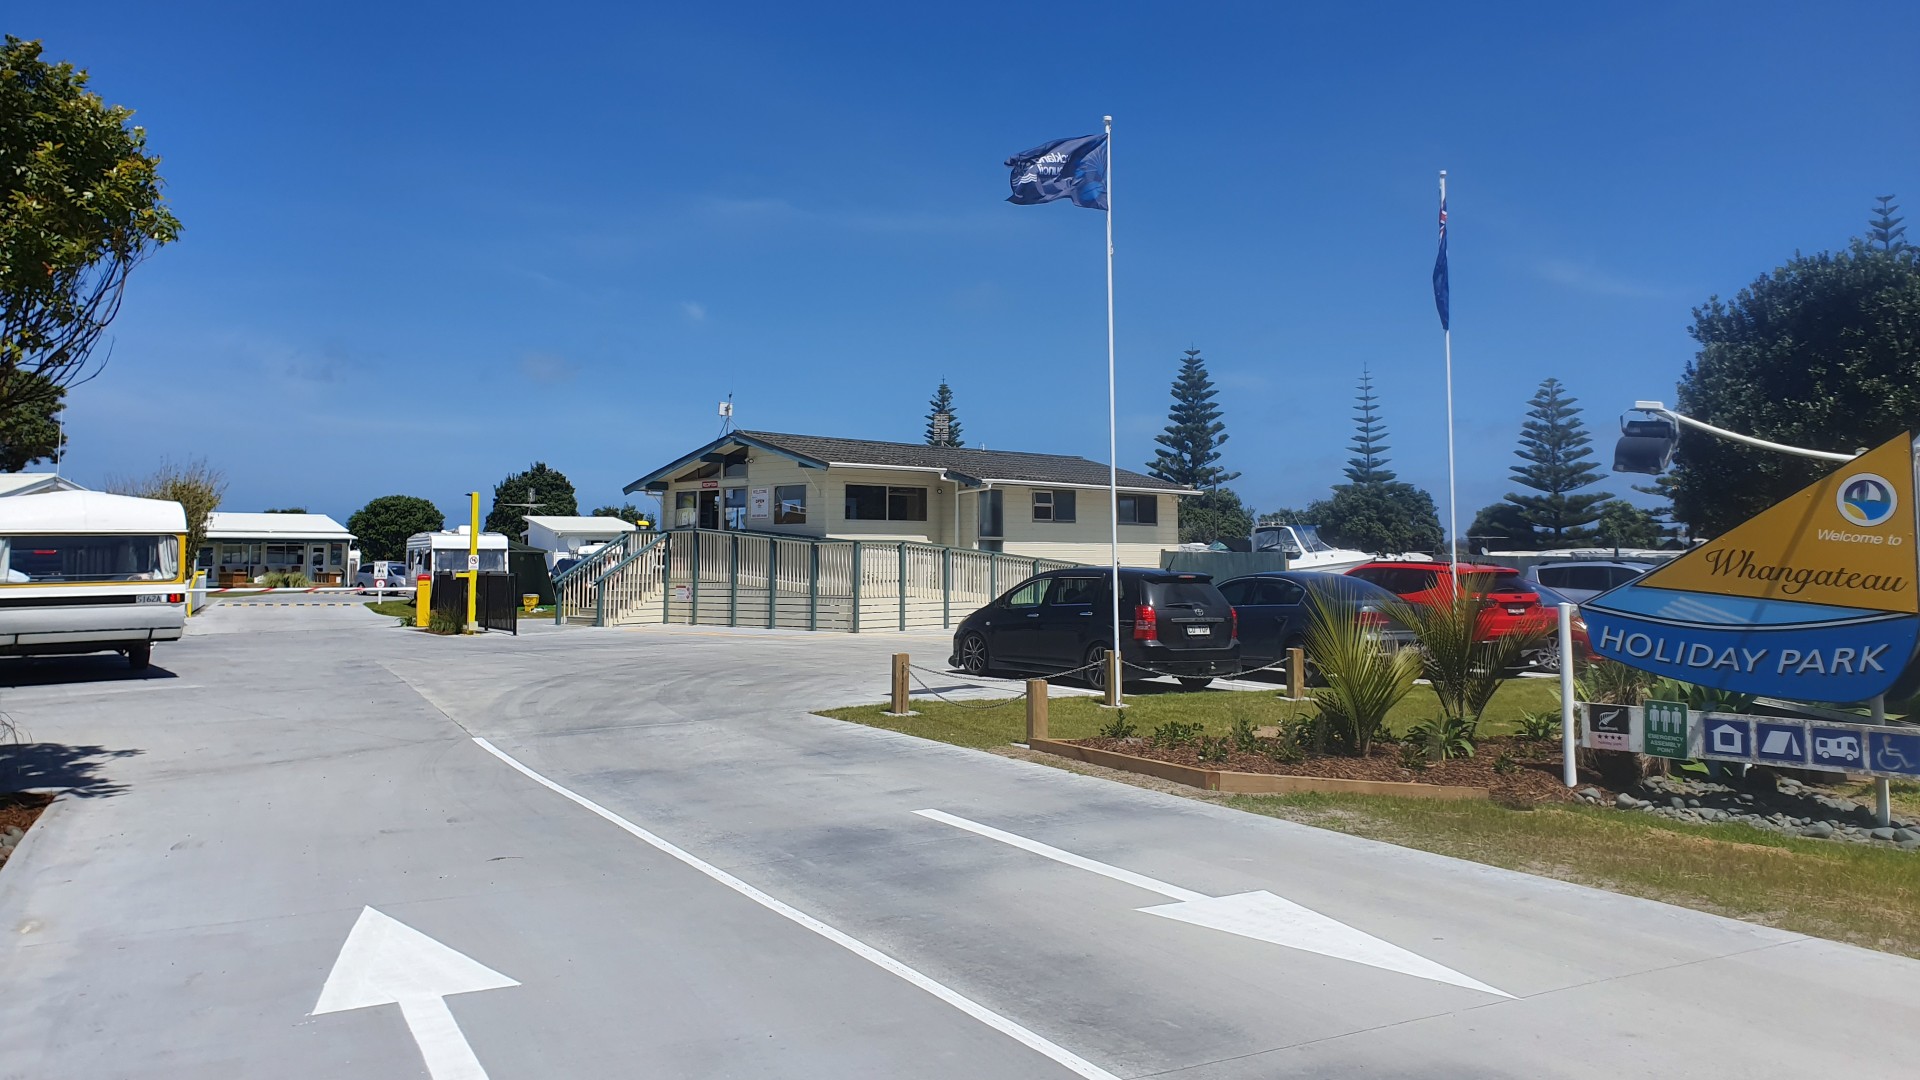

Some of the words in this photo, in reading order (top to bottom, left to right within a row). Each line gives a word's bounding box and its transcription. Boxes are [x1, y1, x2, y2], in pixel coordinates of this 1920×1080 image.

[1818, 529, 1883, 544] Welcome
[1888, 534, 1903, 546] to
[1705, 548, 1909, 595] Whangateau
[1600, 625, 1767, 672] HOLIDAY
[1776, 643, 1889, 674] PARK
[1648, 733, 1683, 742] EMERGENCY
[1650, 740, 1681, 748] ASSEMBLY
